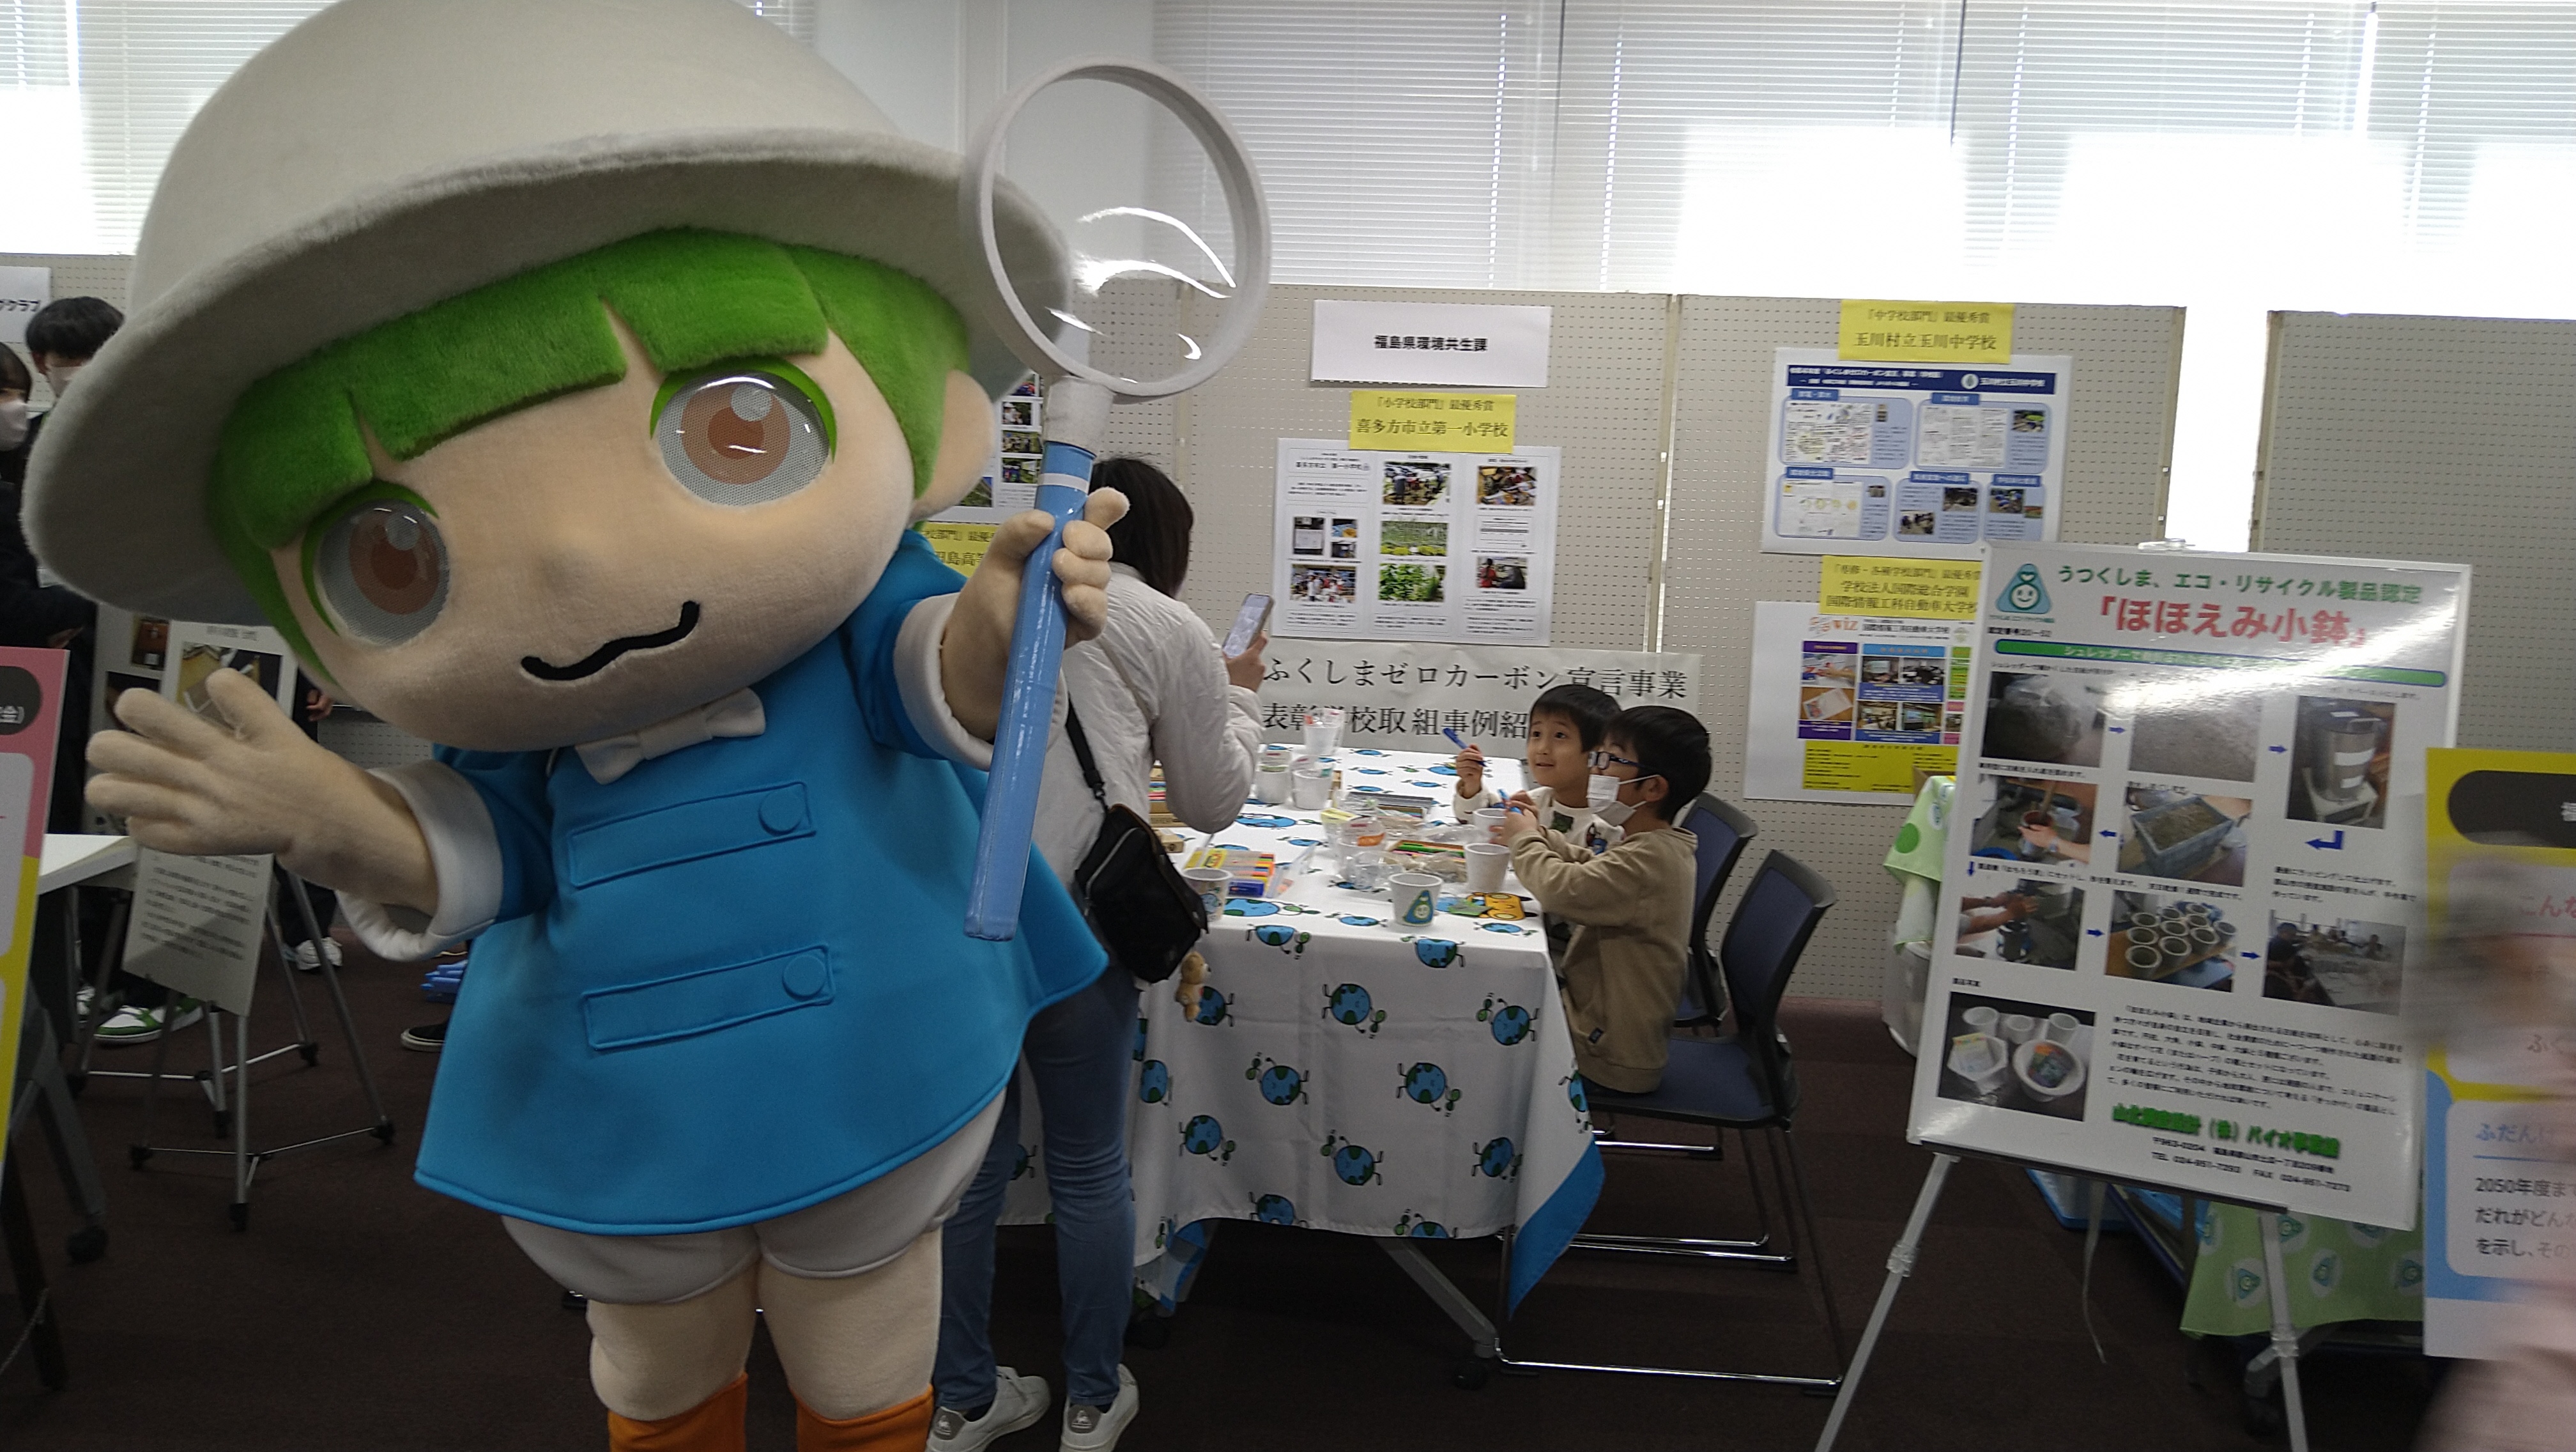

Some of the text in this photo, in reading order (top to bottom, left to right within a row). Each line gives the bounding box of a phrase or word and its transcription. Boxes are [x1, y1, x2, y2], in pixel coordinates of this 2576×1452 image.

[1374, 336, 1487, 351] 福島県環境共生課
[1853, 332, 1997, 350] 玉川村立玉川中学校
[1357, 419, 1508, 437] 喜多方市立第一小学校
[1264, 658, 1688, 699] ふくしまゼロカーボン宣言事業
